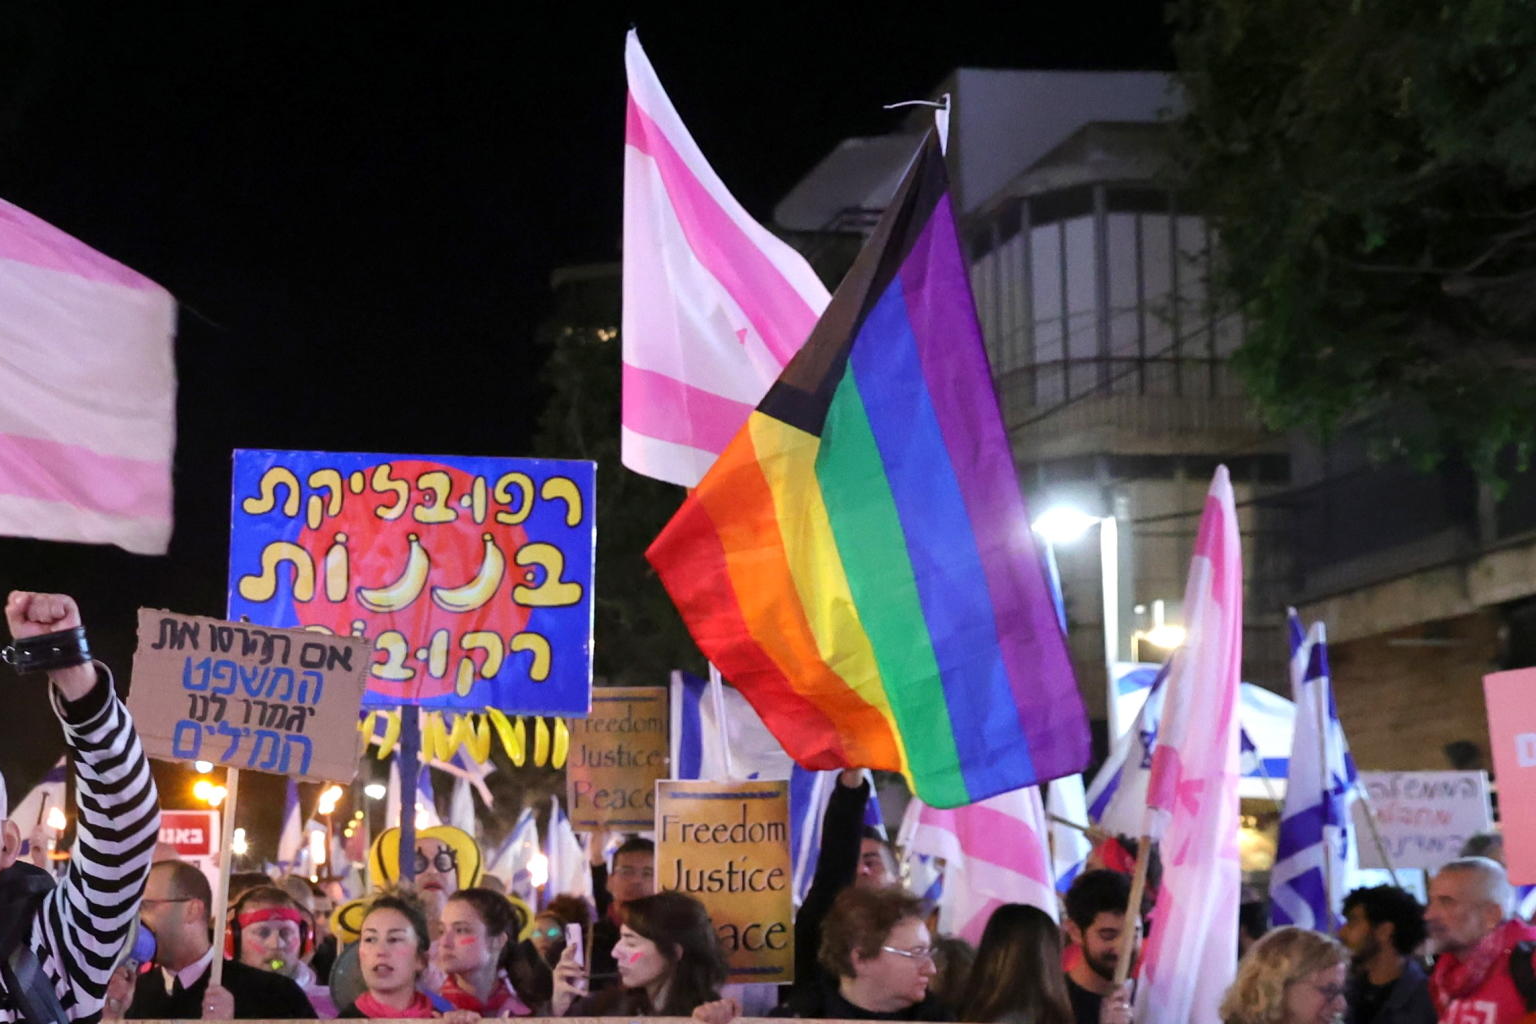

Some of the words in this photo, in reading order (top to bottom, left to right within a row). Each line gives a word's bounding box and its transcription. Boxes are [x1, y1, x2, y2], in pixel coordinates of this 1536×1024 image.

[242, 464, 583, 530] רפובליקת
[151, 618, 200, 651] את
[300, 642, 352, 672] אם
[305, 620, 552, 697] רקוב
[182, 656, 324, 705] המשפט
[188, 692, 228, 723] לנו
[241, 699, 316, 733] יגמרו
[172, 720, 313, 776] המילים
[572, 744, 660, 769] Justice
[661, 804, 786, 844] Freedom
[662, 855, 785, 893] Justice
[710, 921, 787, 951] ace
